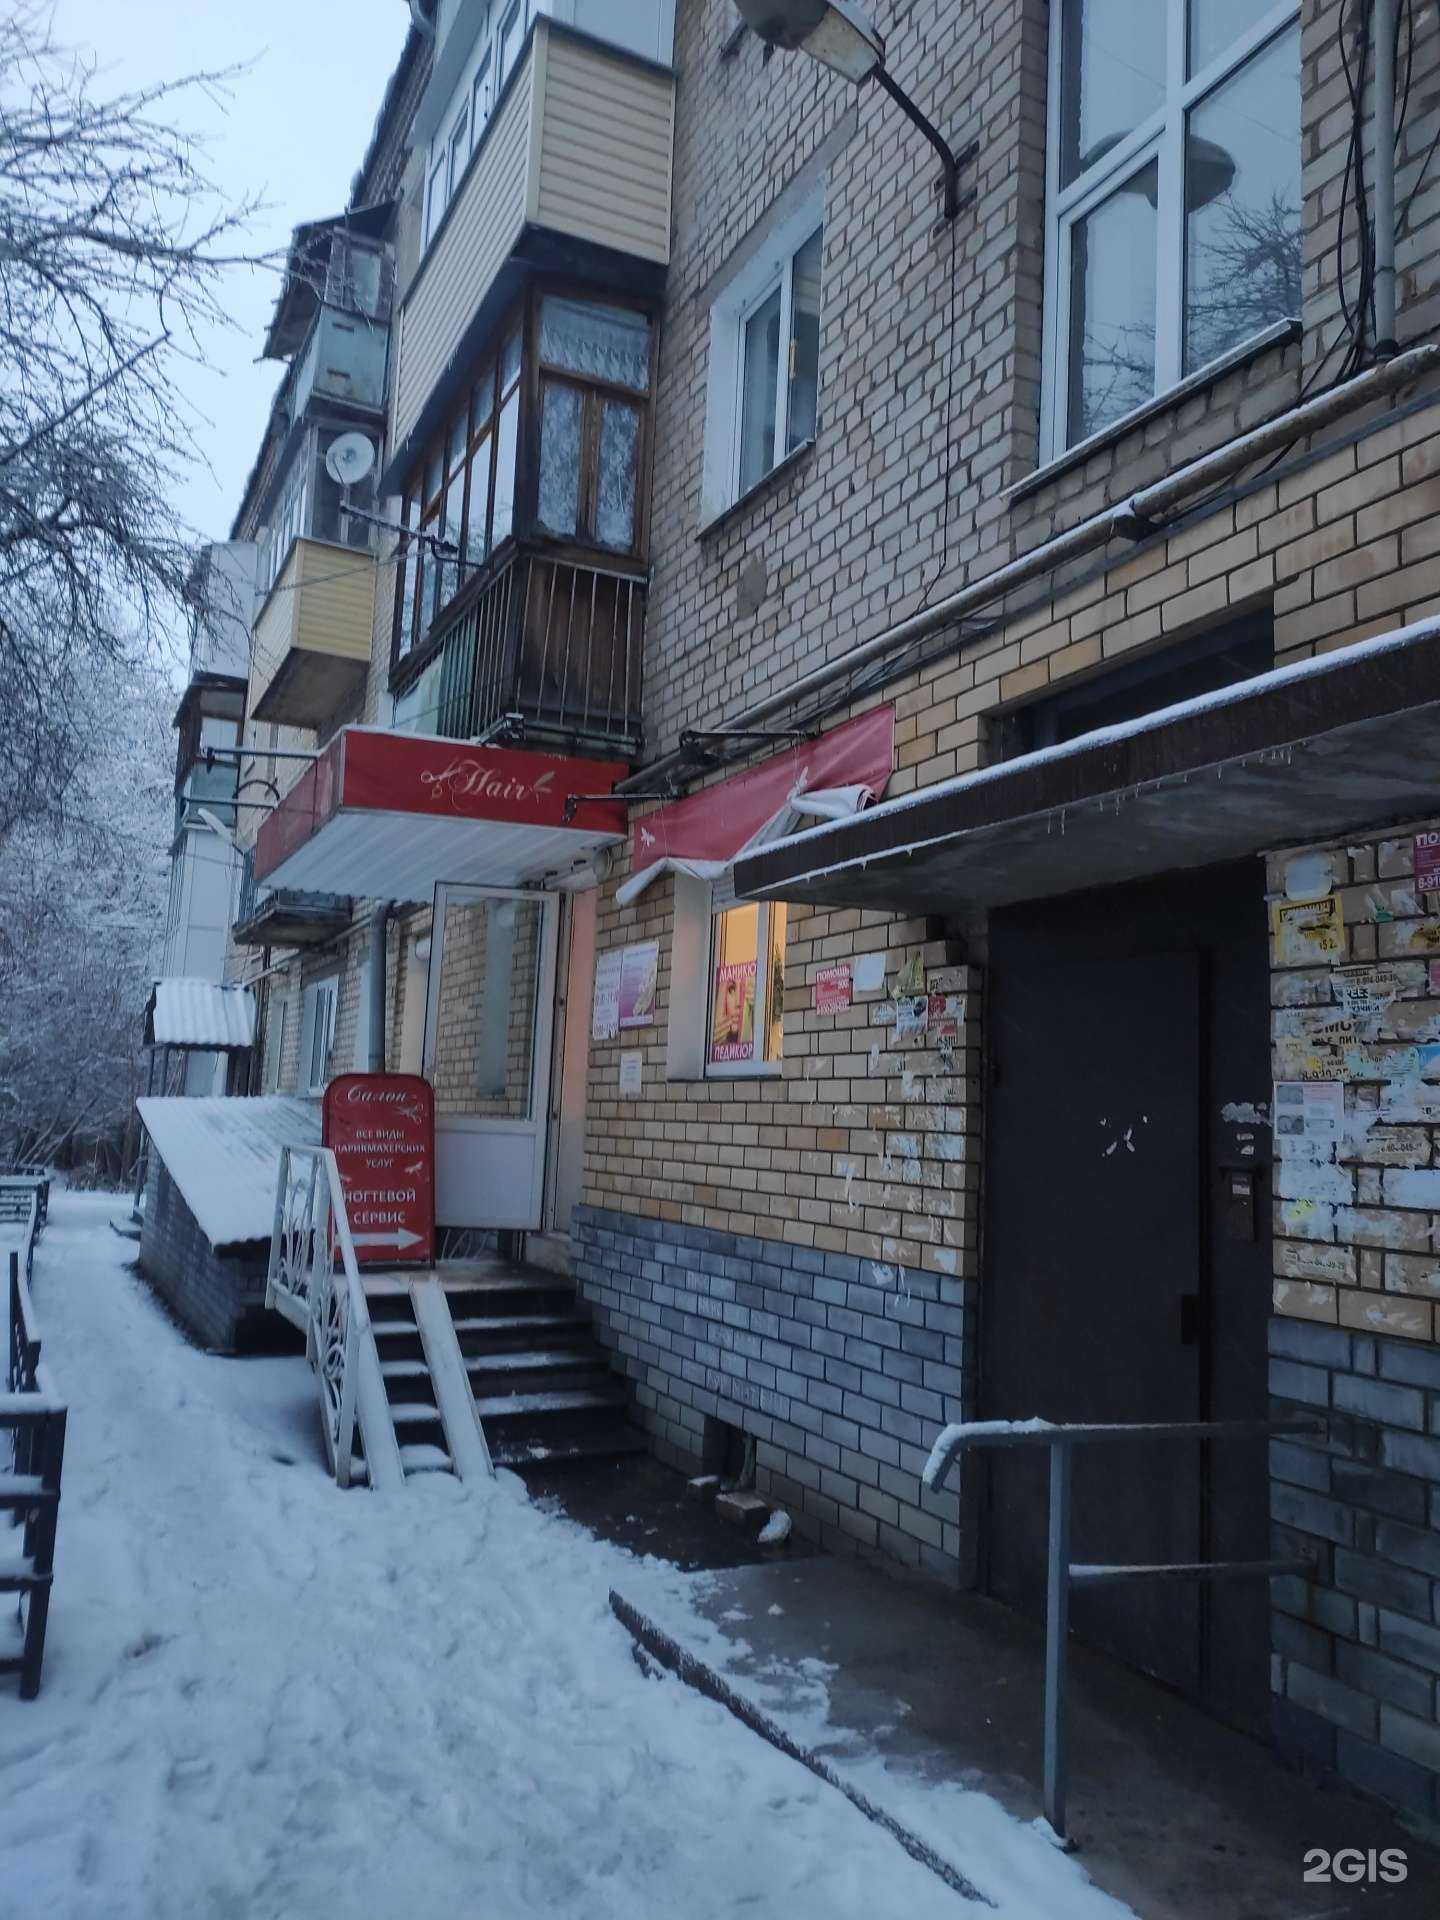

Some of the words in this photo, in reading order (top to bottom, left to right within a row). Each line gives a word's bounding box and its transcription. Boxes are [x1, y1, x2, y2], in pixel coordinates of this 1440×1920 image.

[451, 759, 526, 802] Hair
[1415, 833, 1440, 846] ПО
[714, 1043, 753, 1062] ПЕДИКЮР
[347, 1084, 407, 1105] Салон
[356, 1128, 375, 1140] ВСЕ
[376, 1128, 405, 1140] ВИДЫ
[335, 1142, 425, 1154] ПАРИКМАХЕРСКИХ
[366, 1158, 393, 1169] УСЛУГ
[344, 1187, 416, 1204] НОГТЕВОЙ
[353, 1210, 406, 1225] СЕРВИС
